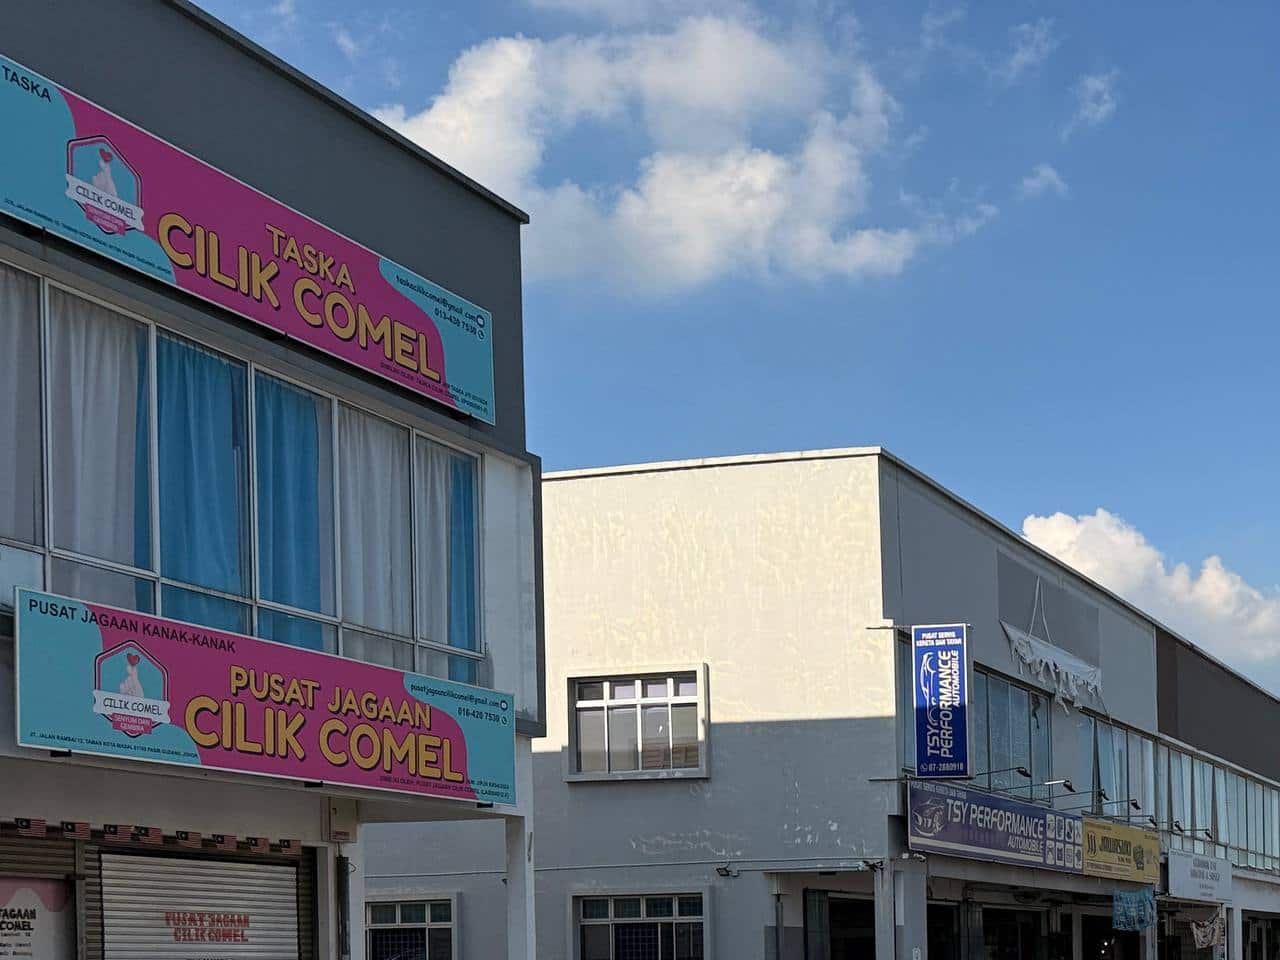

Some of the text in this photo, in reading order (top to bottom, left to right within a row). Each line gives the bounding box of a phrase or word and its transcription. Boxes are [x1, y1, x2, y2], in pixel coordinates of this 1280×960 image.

[2, 65, 52, 103] TASKA
[75, 185, 103, 206] CILIK
[104, 198, 137, 220] COMEL
[265, 223, 356, 294] TASKA
[157, 213, 281, 309] CILIK
[293, 277, 442, 384] COMEL
[28, 599, 236, 652] PUSAT JAGAAN KANAK-KANAK
[230, 665, 432, 730] PUSAT JAGAAN
[951, 649, 961, 707] AUTOMOBILE
[103, 697, 162, 716] CILIK COMEL
[938, 650, 954, 758] PERFORMANCE
[184, 696, 464, 783] CILIK COMEL
[927, 726, 940, 757] TSY
[946, 798, 1045, 839] TSY PERFORMANCE
[1007, 835, 1045, 851] AUTOMOBILE
[0, 908, 36, 919] AGAAN
